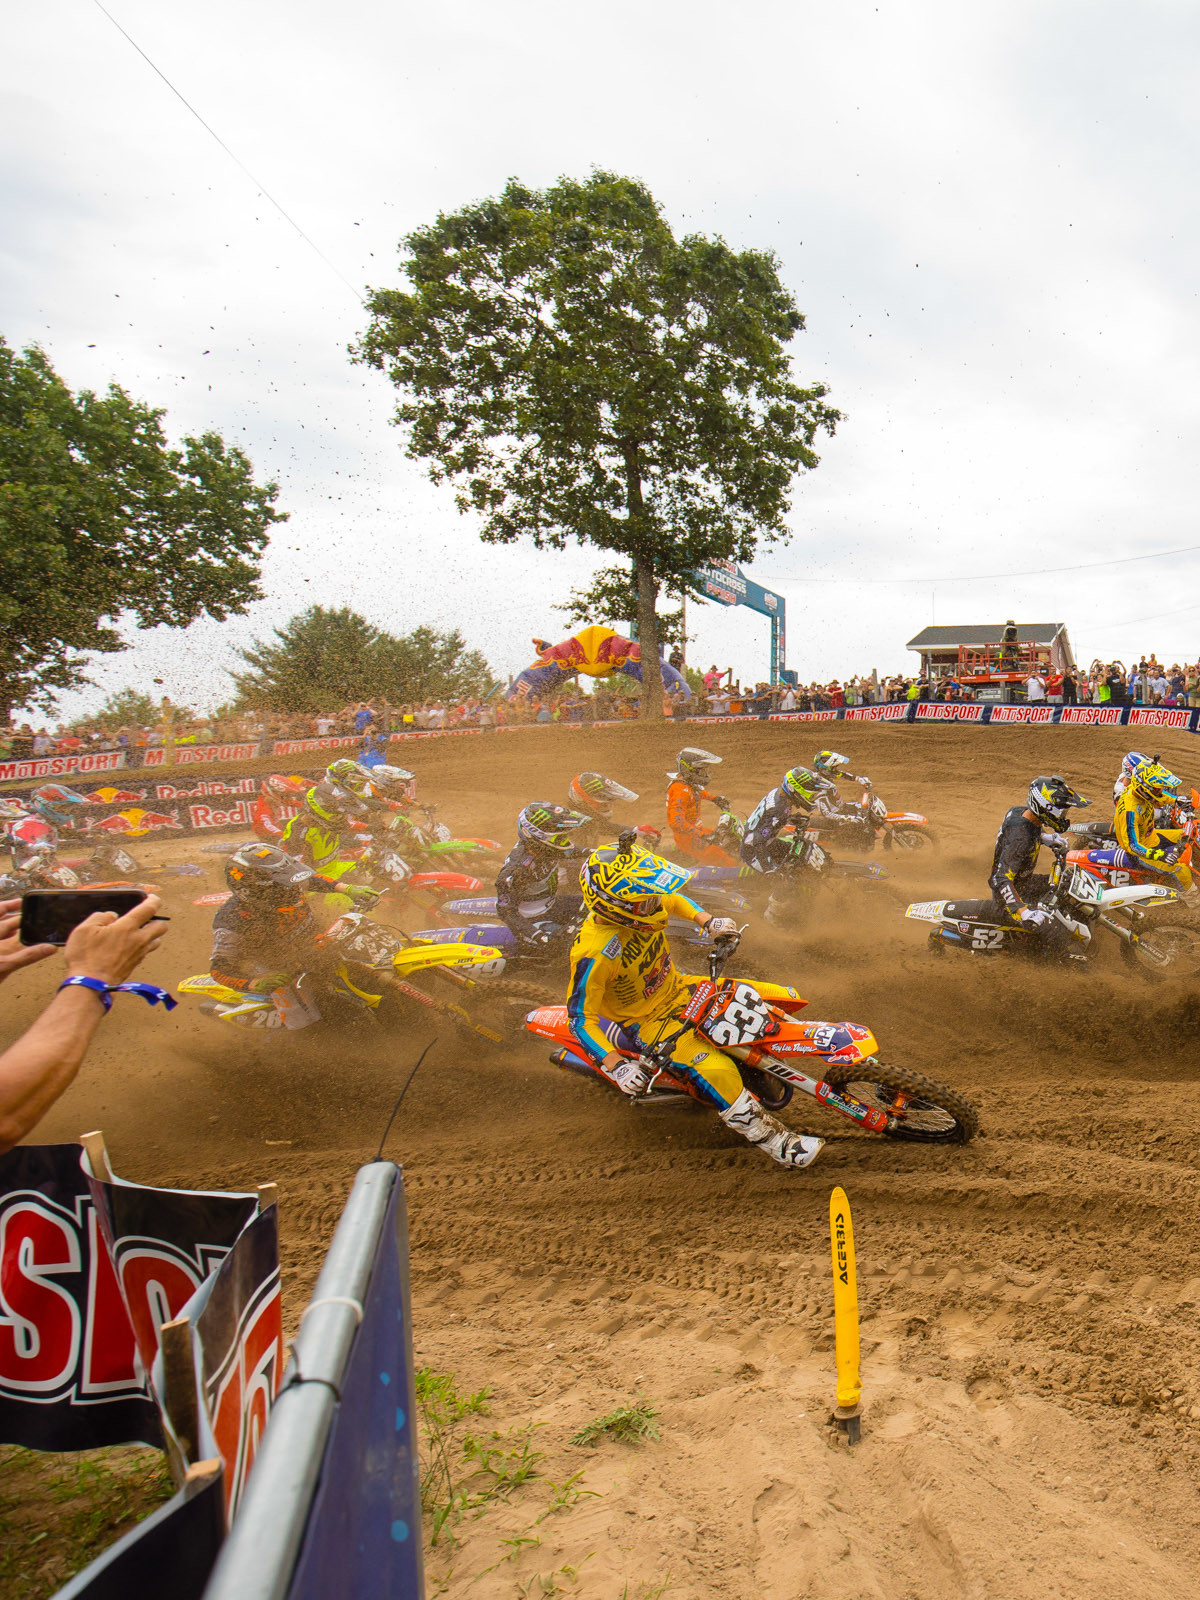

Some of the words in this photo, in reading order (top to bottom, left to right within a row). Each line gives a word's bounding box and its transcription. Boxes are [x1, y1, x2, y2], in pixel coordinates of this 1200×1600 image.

[189, 800, 249, 829] Red
[1109, 869, 1130, 887] 12
[1000, 885, 1016, 904] FLY
[971, 928, 1004, 950] 52
[252, 1010, 283, 1029] 26
[711, 983, 769, 1048] 233
[782, 1043, 793, 1052] Lee
[793, 1043, 817, 1054] Designs
